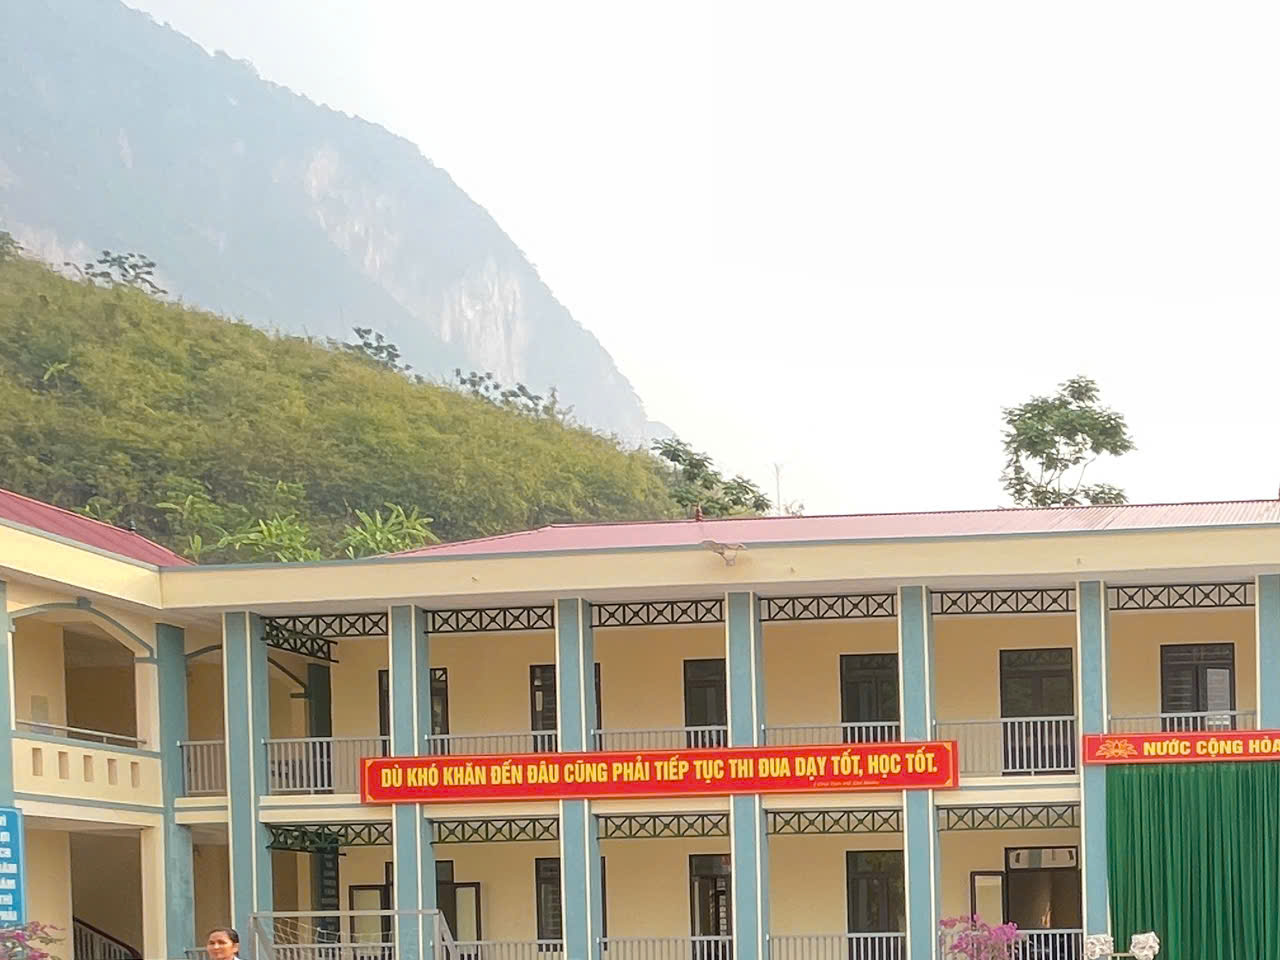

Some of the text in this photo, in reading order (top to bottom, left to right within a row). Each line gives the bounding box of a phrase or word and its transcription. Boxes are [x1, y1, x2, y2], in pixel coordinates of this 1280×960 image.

[1143, 738, 1191, 756] NƯỚC
[1196, 737, 1243, 758] CỘNG
[381, 764, 403, 787] DÙ
[407, 762, 439, 787] KHÓ
[443, 762, 487, 786] KHĂN
[490, 759, 523, 785] ĐẾN
[527, 760, 559, 784] ĐÂU
[564, 760, 608, 783] CŨNG
[612, 756, 650, 781] PHẢI
[654, 754, 689, 780] TIẾP
[693, 760, 724, 784] TỤC
[728, 758, 754, 779] THI
[758, 757, 790, 778] ĐUA
[795, 755, 827, 781] DẠY
[831, 749, 863, 778] TỐT,
[868, 753, 901, 779] HỌC
